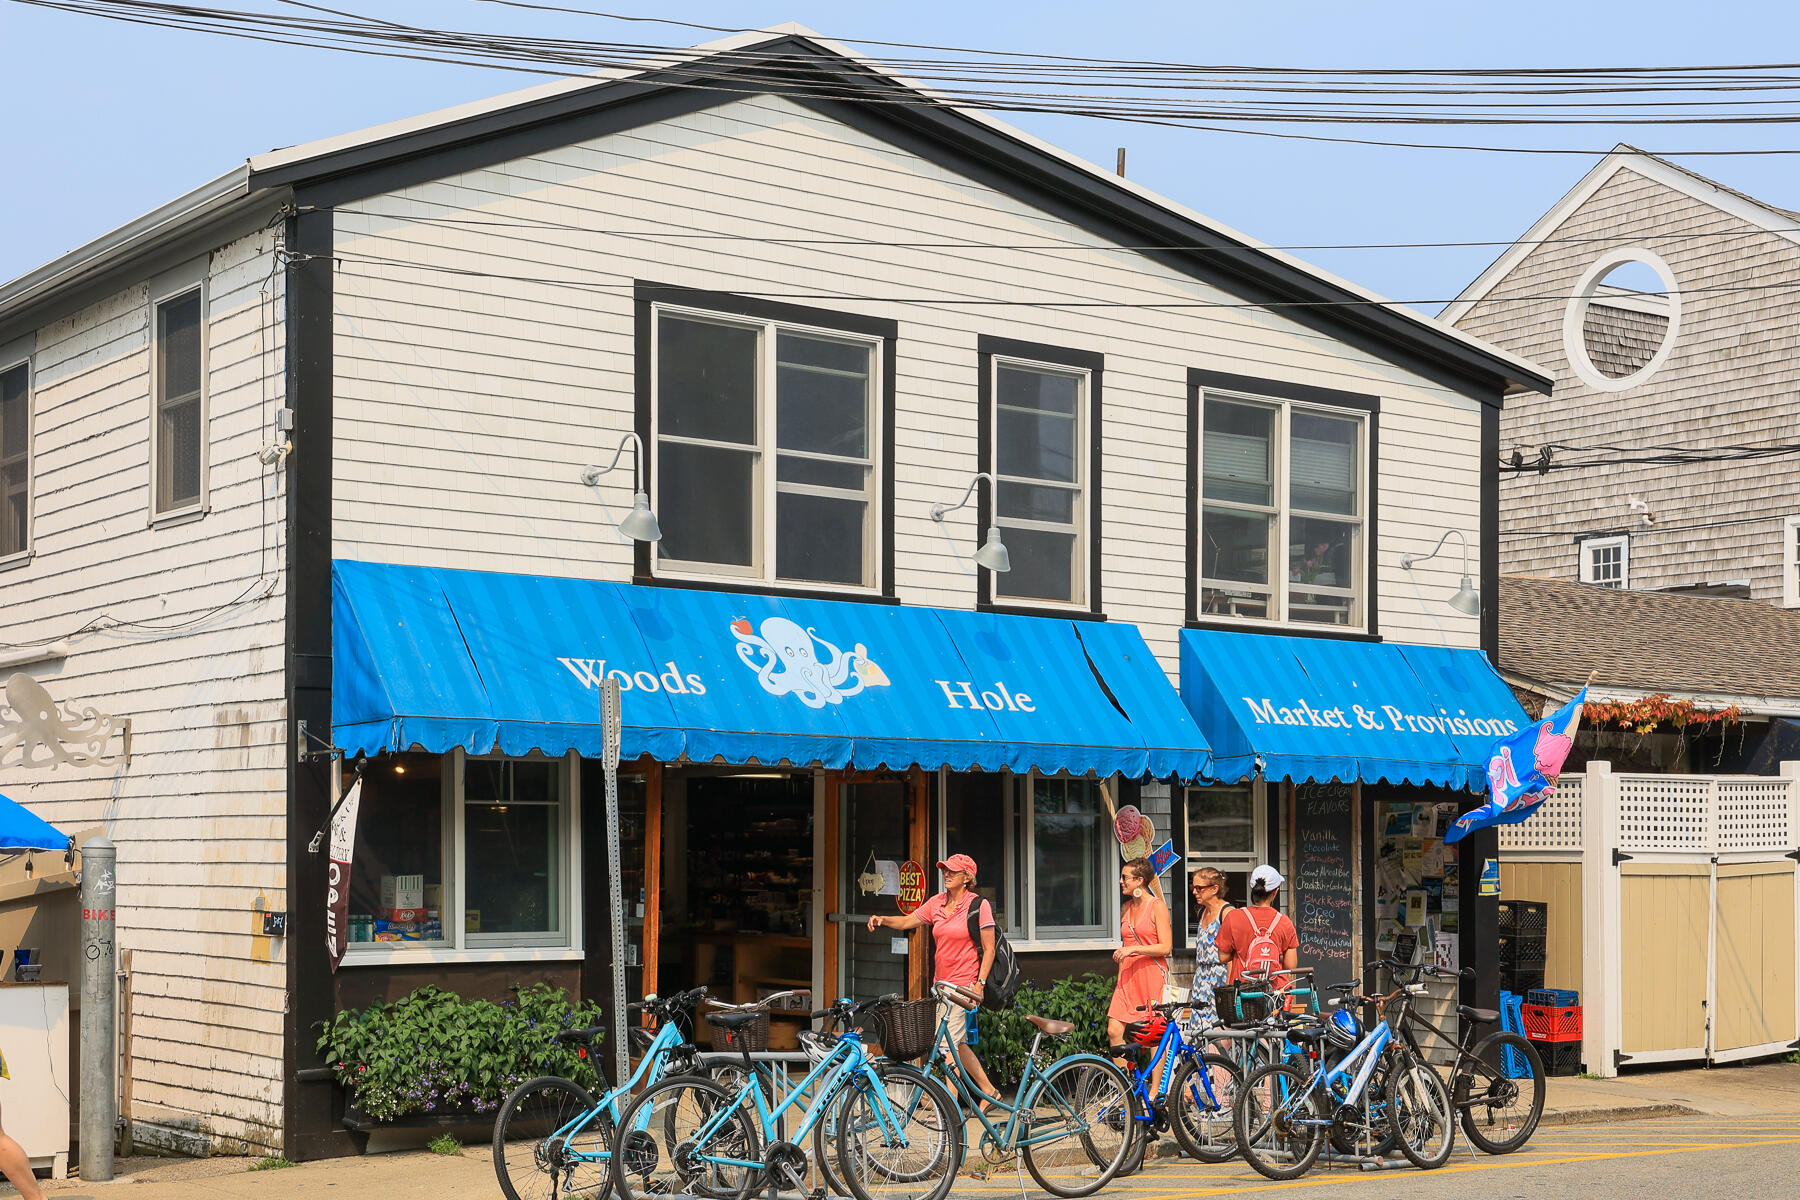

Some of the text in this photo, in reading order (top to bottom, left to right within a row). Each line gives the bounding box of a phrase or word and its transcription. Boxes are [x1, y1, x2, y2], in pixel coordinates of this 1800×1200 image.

[556, 657, 707, 695] Woods
[935, 680, 1036, 712] Hole
[1242, 696, 1518, 737] Market & Provisions
[898, 887, 921, 902] PIZZA
[900, 871, 921, 886] BEST
[83, 909, 115, 921] BIKE
[1158, 1050, 1173, 1094] PECIALIZED
[816, 1069, 847, 1115] TREK
